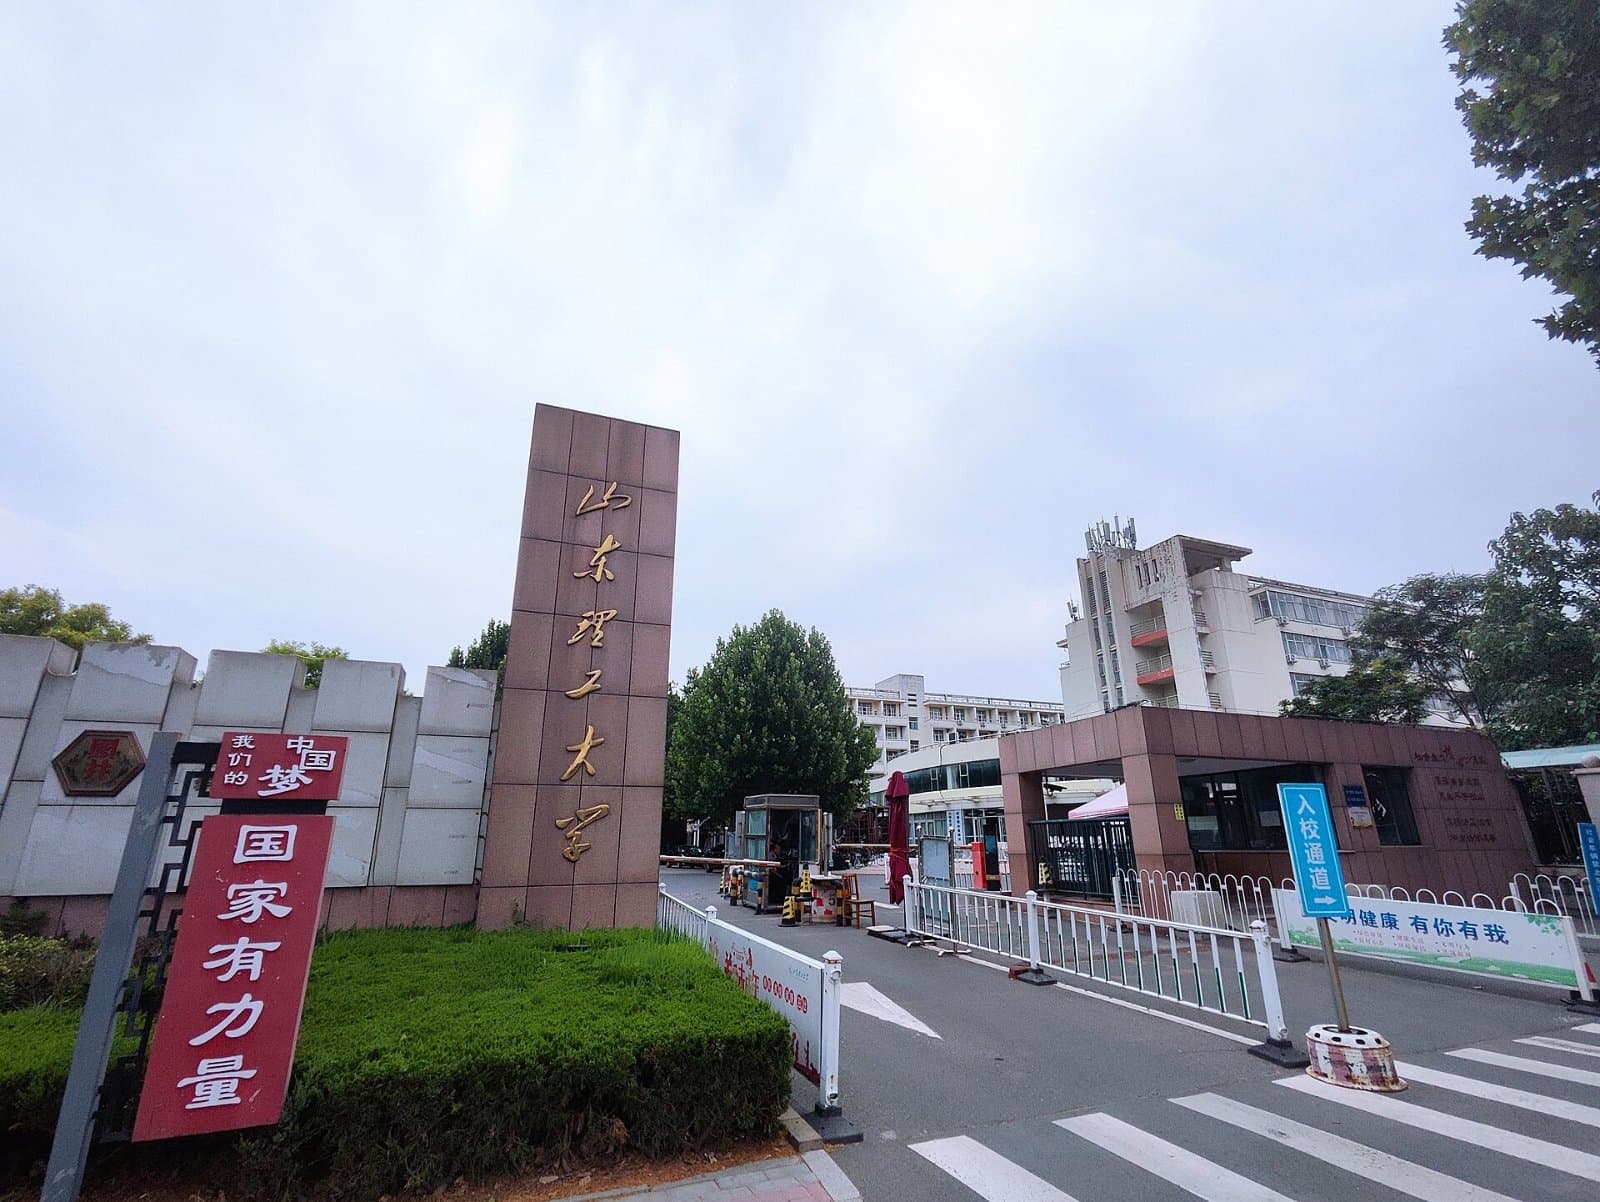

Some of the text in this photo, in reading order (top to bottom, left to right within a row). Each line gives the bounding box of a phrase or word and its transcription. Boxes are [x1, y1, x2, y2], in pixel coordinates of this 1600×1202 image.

[556, 481, 632, 862] 山东理工大学
[223, 735, 256, 785] 我们的
[257, 735, 336, 797] 中国梦
[1297, 794, 1331, 890] 入校通道
[1328, 909, 1510, 945] 明健康 有你有我
[177, 824, 298, 1110] 国家有力量
